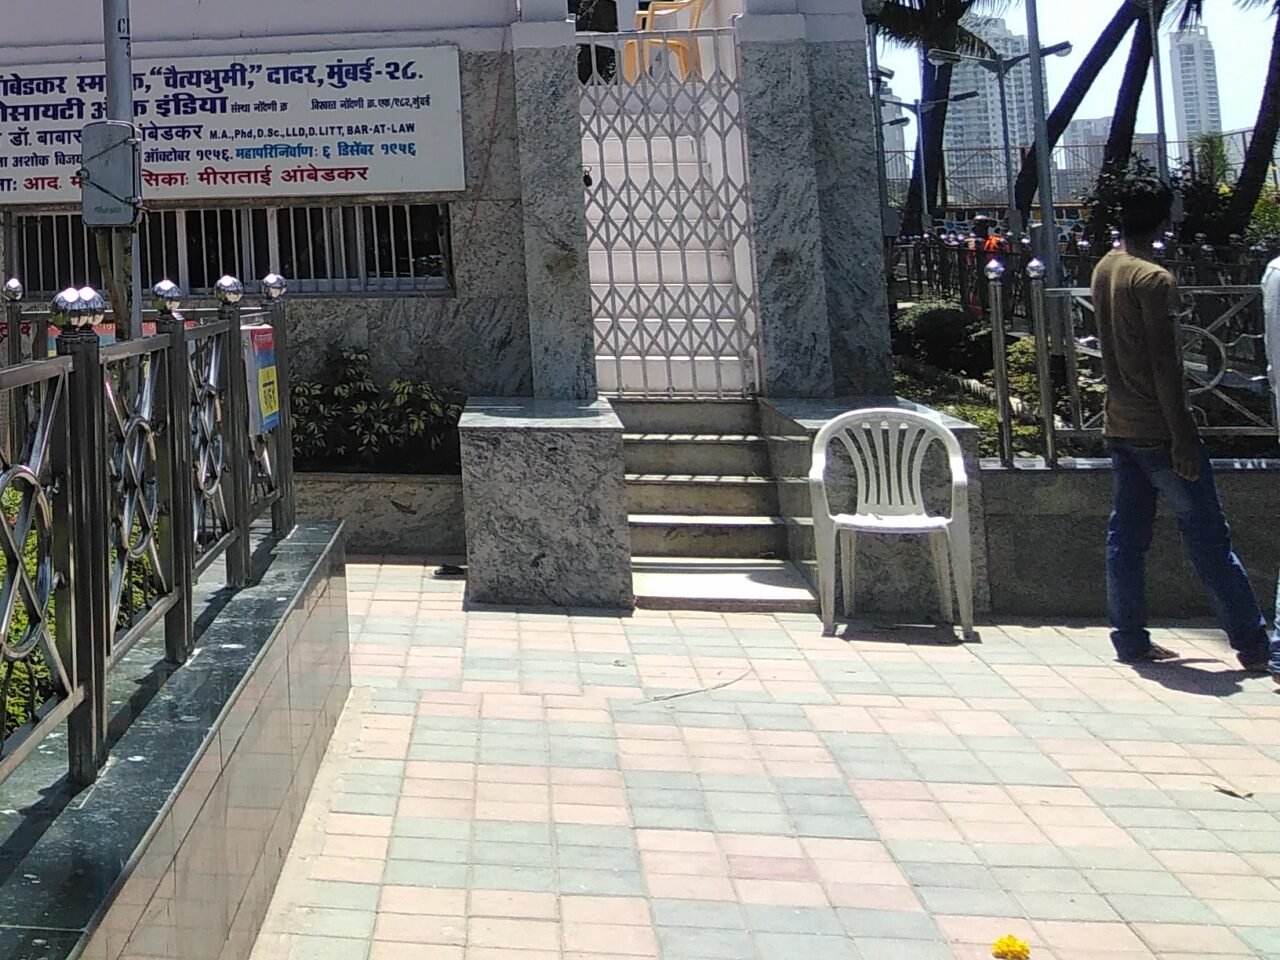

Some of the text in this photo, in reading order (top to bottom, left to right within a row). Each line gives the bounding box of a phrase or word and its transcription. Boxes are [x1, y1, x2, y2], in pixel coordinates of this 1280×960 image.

[155, 91, 229, 118] इंडिया
[12, 152, 50, 168] अशोक
[322, 145, 331, 159] ६
[337, 141, 375, 156] डिसेंबर
[380, 142, 417, 156] १९५६
[197, 165, 272, 186] मीराताई
[280, 163, 369, 183] आंबेडकर
